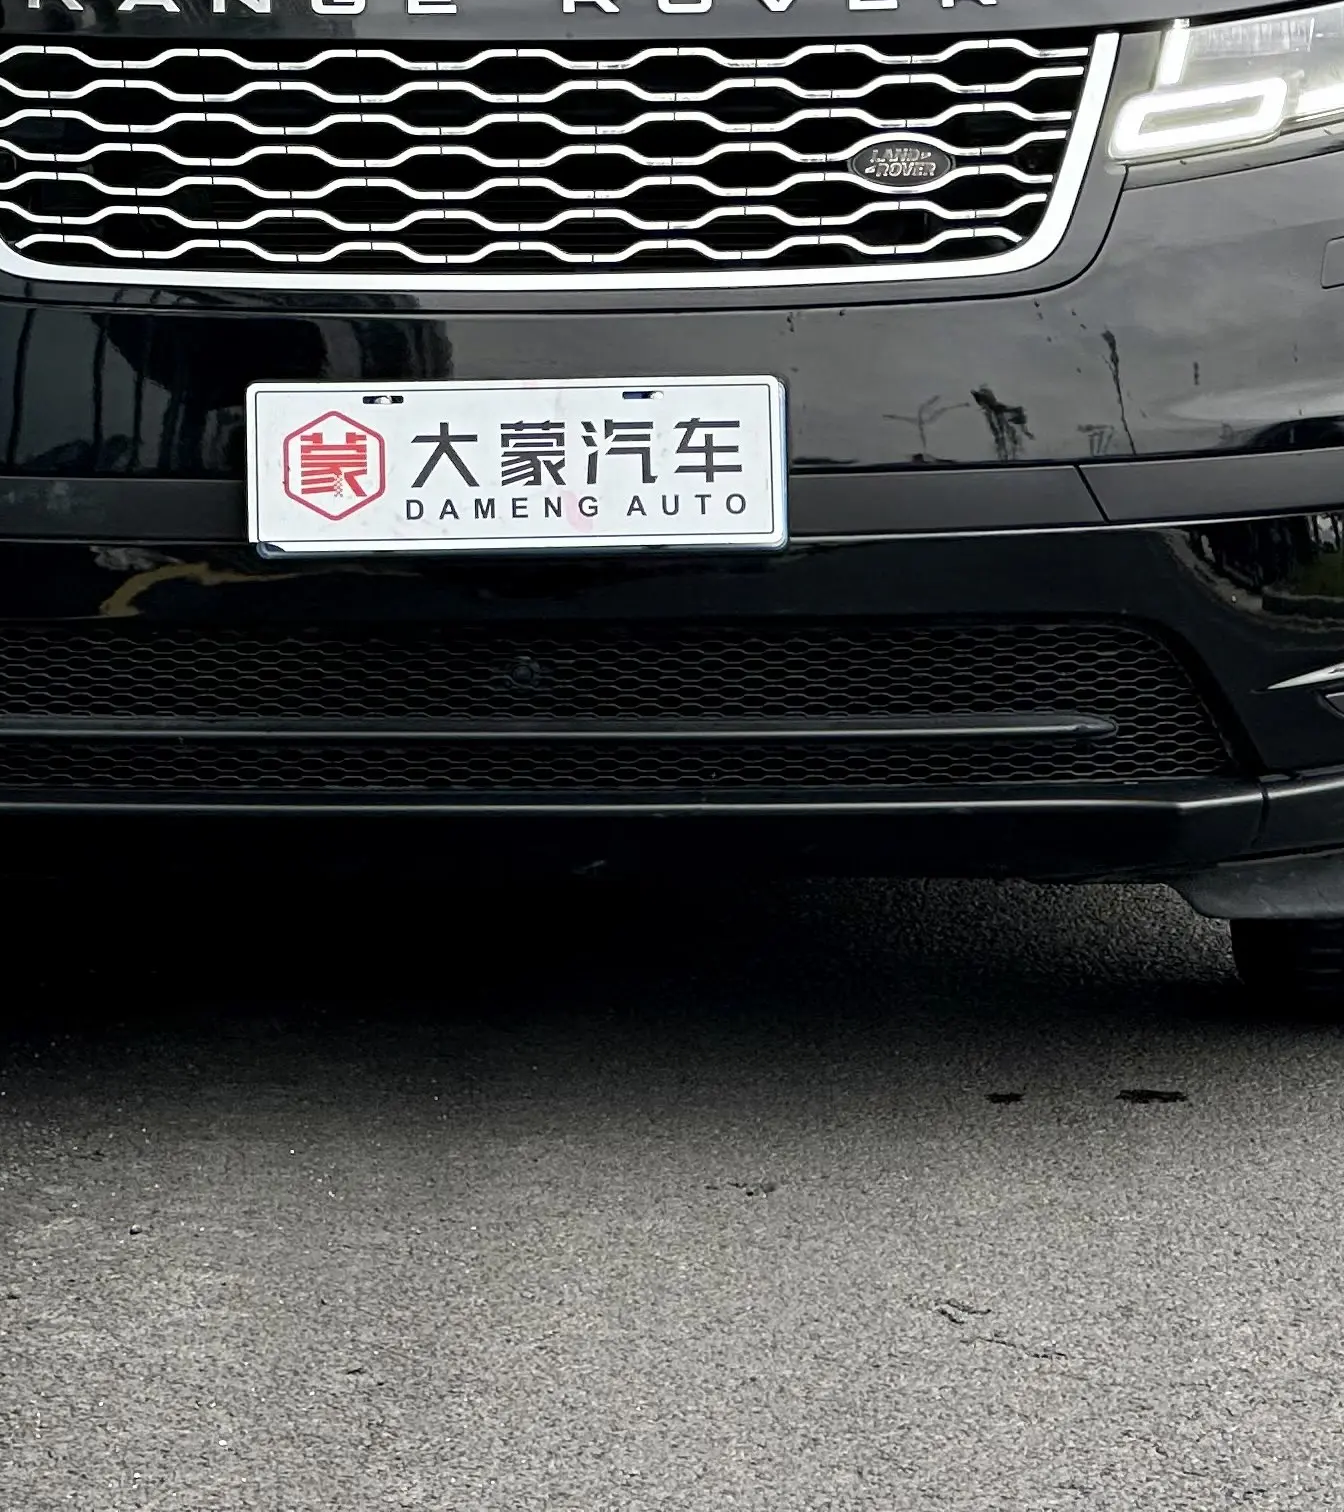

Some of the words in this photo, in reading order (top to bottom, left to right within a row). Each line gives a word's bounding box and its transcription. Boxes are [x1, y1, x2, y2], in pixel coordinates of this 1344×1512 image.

[875, 161, 936, 177] ROVER
[410, 417, 743, 488] 大蒙汽车
[406, 496, 599, 521] DAMENG
[627, 492, 748, 517] AUTO
